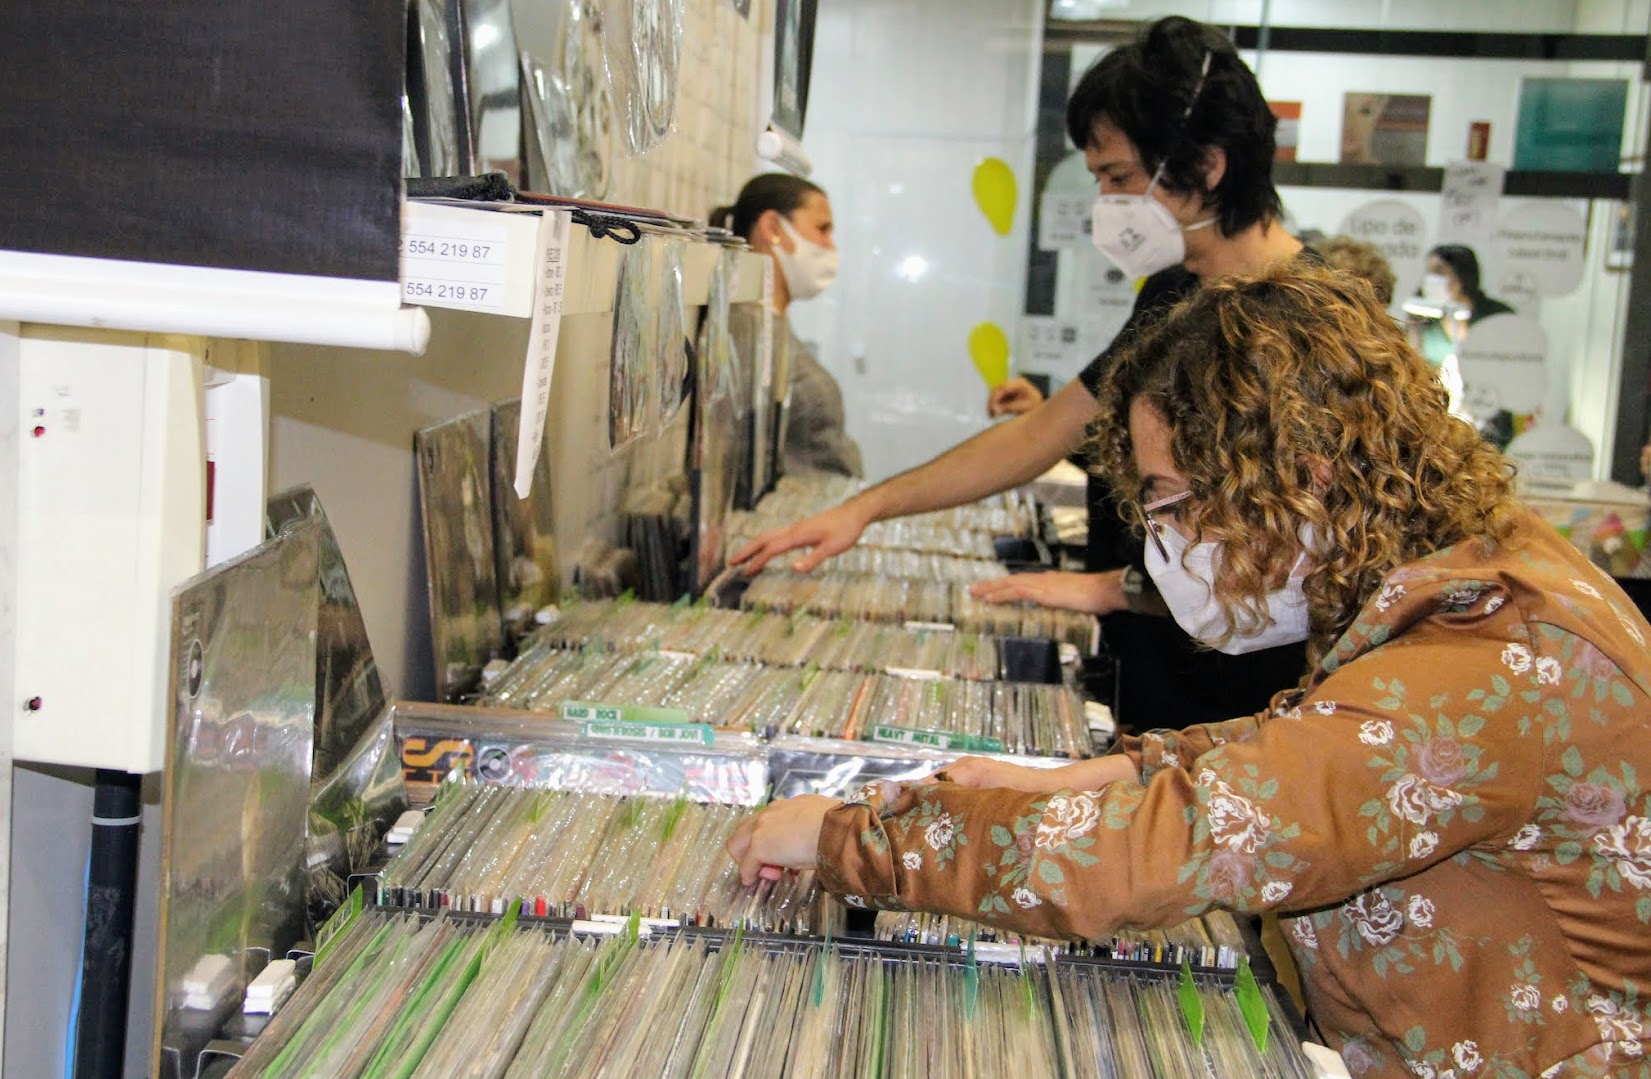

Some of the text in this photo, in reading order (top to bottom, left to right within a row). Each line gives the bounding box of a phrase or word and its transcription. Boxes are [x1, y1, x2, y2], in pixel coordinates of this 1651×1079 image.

[408, 240, 435, 254] 554
[440, 243, 468, 257] 219
[472, 246, 490, 259] 87
[406, 282, 488, 301] 554 219 87
